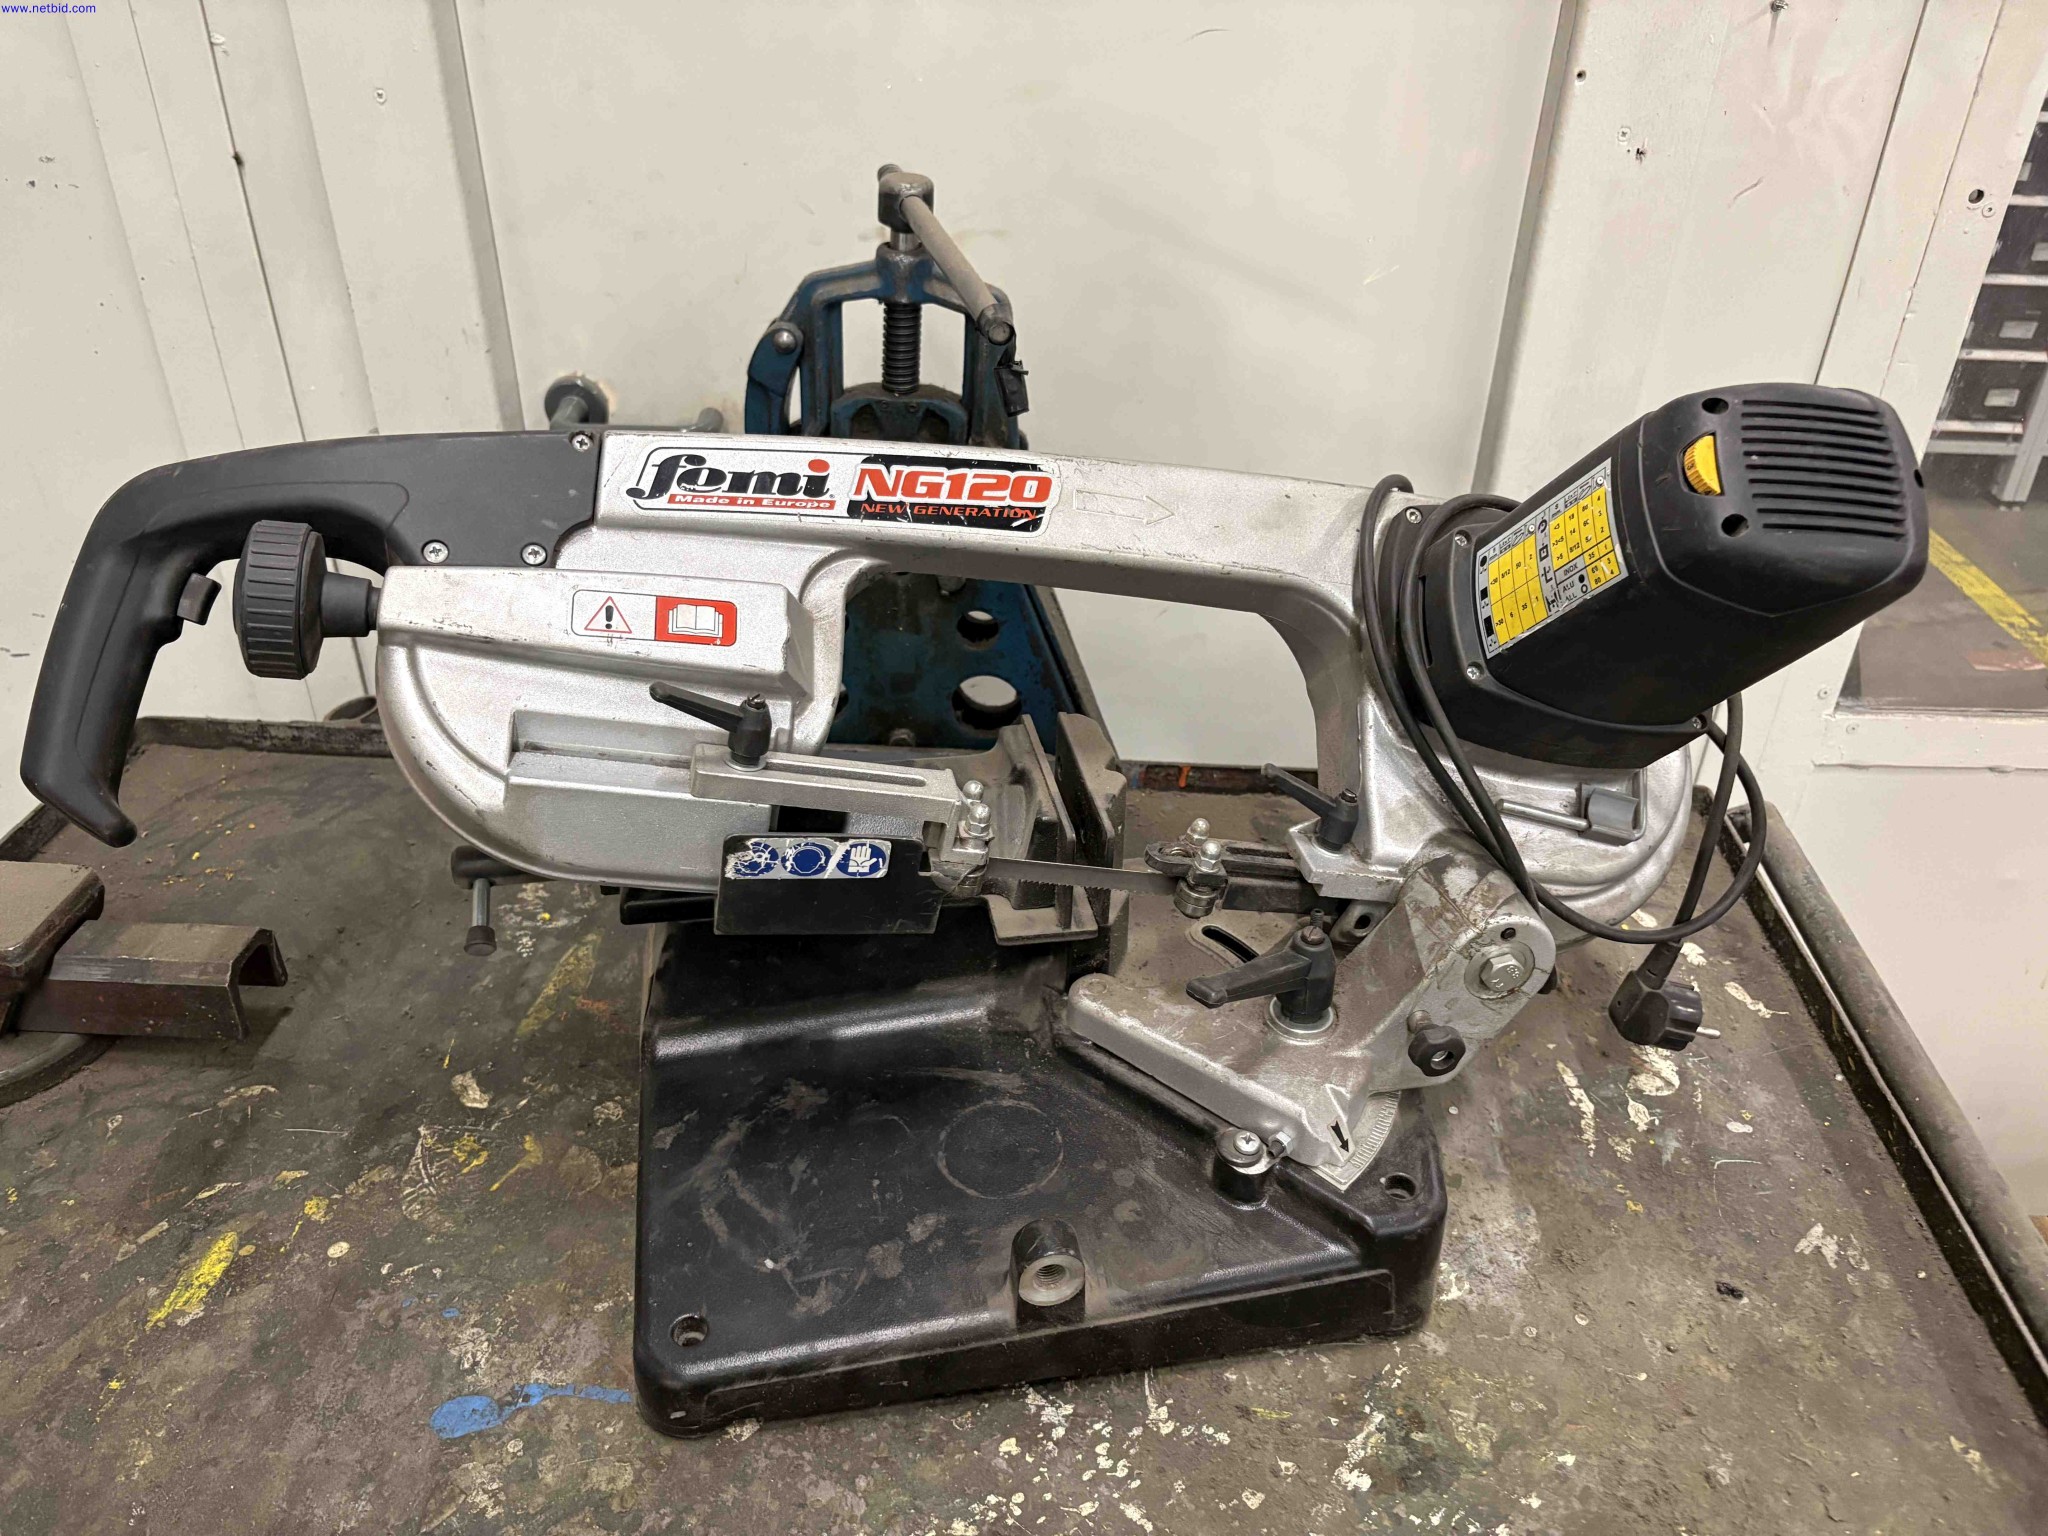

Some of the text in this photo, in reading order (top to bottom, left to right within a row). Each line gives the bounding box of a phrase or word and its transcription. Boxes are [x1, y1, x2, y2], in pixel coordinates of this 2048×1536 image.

[626, 454, 831, 500] femi
[853, 468, 1053, 503] NG120
[674, 494, 832, 509] Made in Europe
[860, 502, 1037, 520] NEW GENERATION
[1563, 562, 1578, 577] INOX
